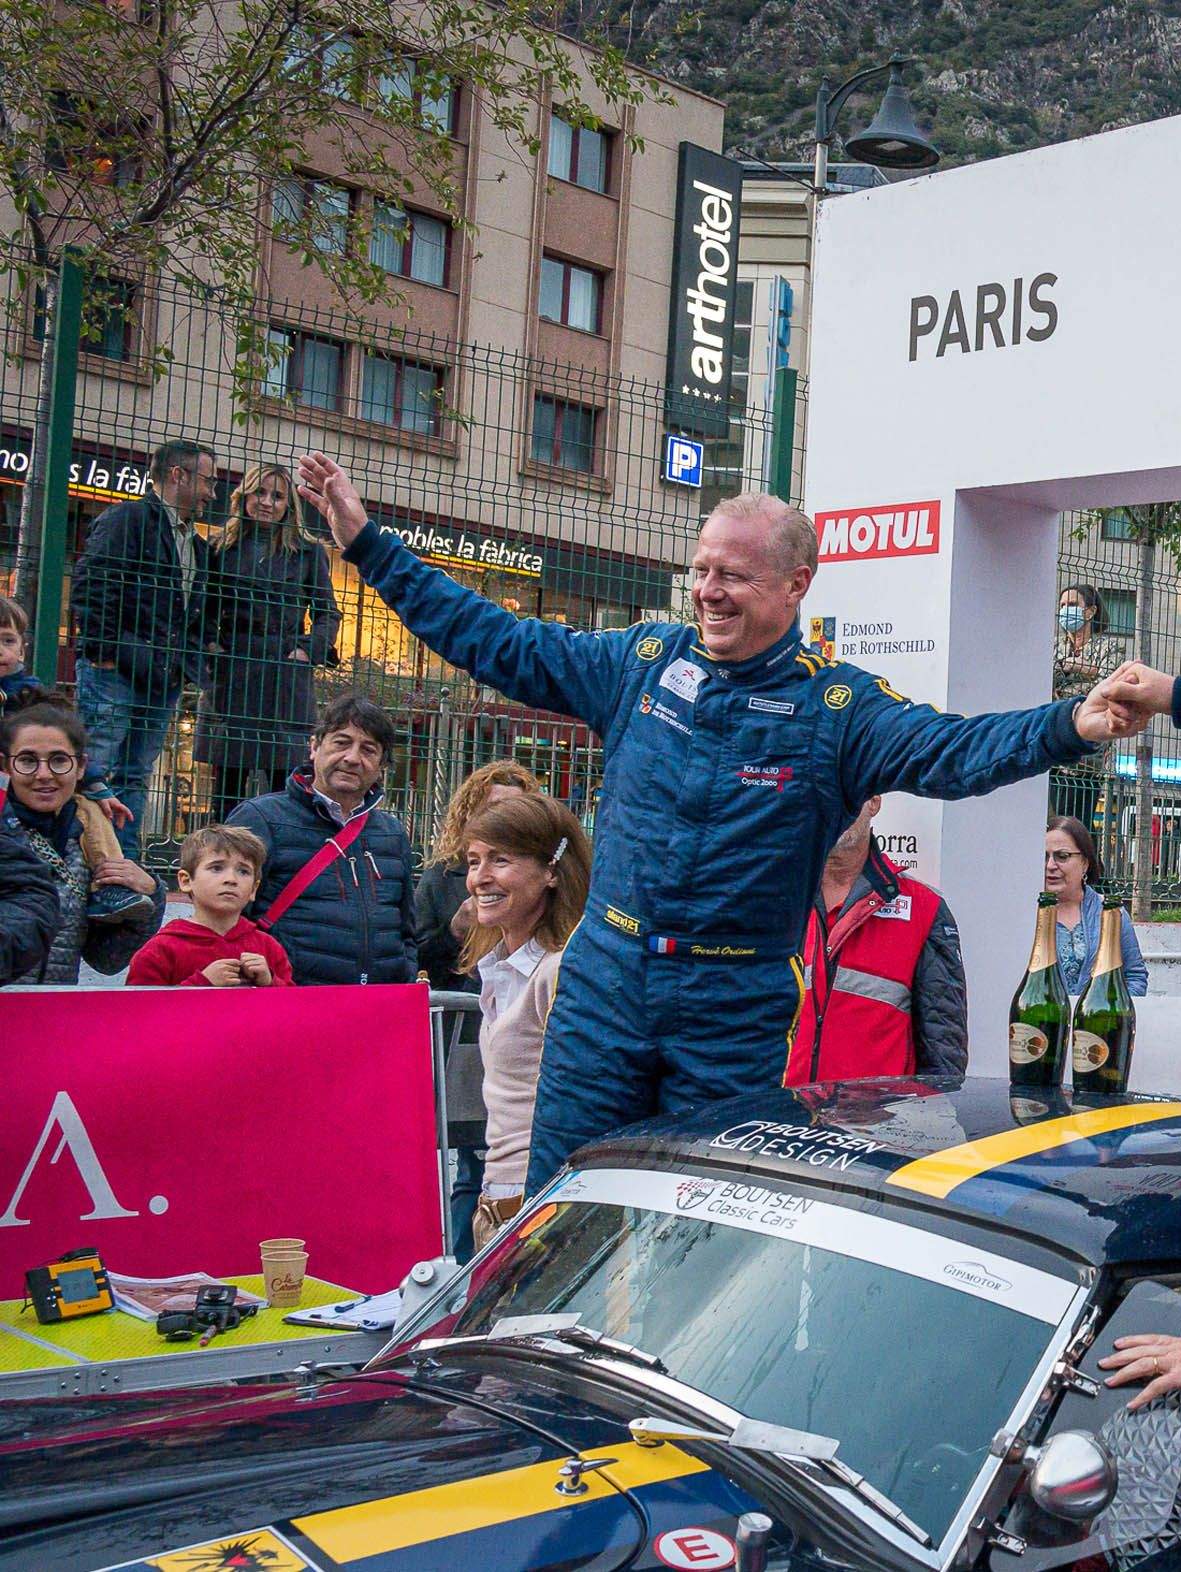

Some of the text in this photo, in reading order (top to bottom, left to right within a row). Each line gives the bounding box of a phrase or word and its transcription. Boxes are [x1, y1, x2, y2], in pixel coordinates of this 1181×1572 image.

[687, 180, 733, 384] arthotel
[909, 272, 1058, 362] PARIS
[819, 509, 934, 556] MOTUL
[842, 622, 893, 637] EDMOND
[842, 639, 935, 656] DE ROTHSCHILD
[879, 834, 918, 854] orra
[740, 1136, 860, 1172] DESIGN
[766, 1121, 887, 1155] BOUTSEN
[719, 1182, 816, 1214] BOUTSEN
[707, 1199, 800, 1230] Classic Cars
[672, 1534, 720, 1562] E
